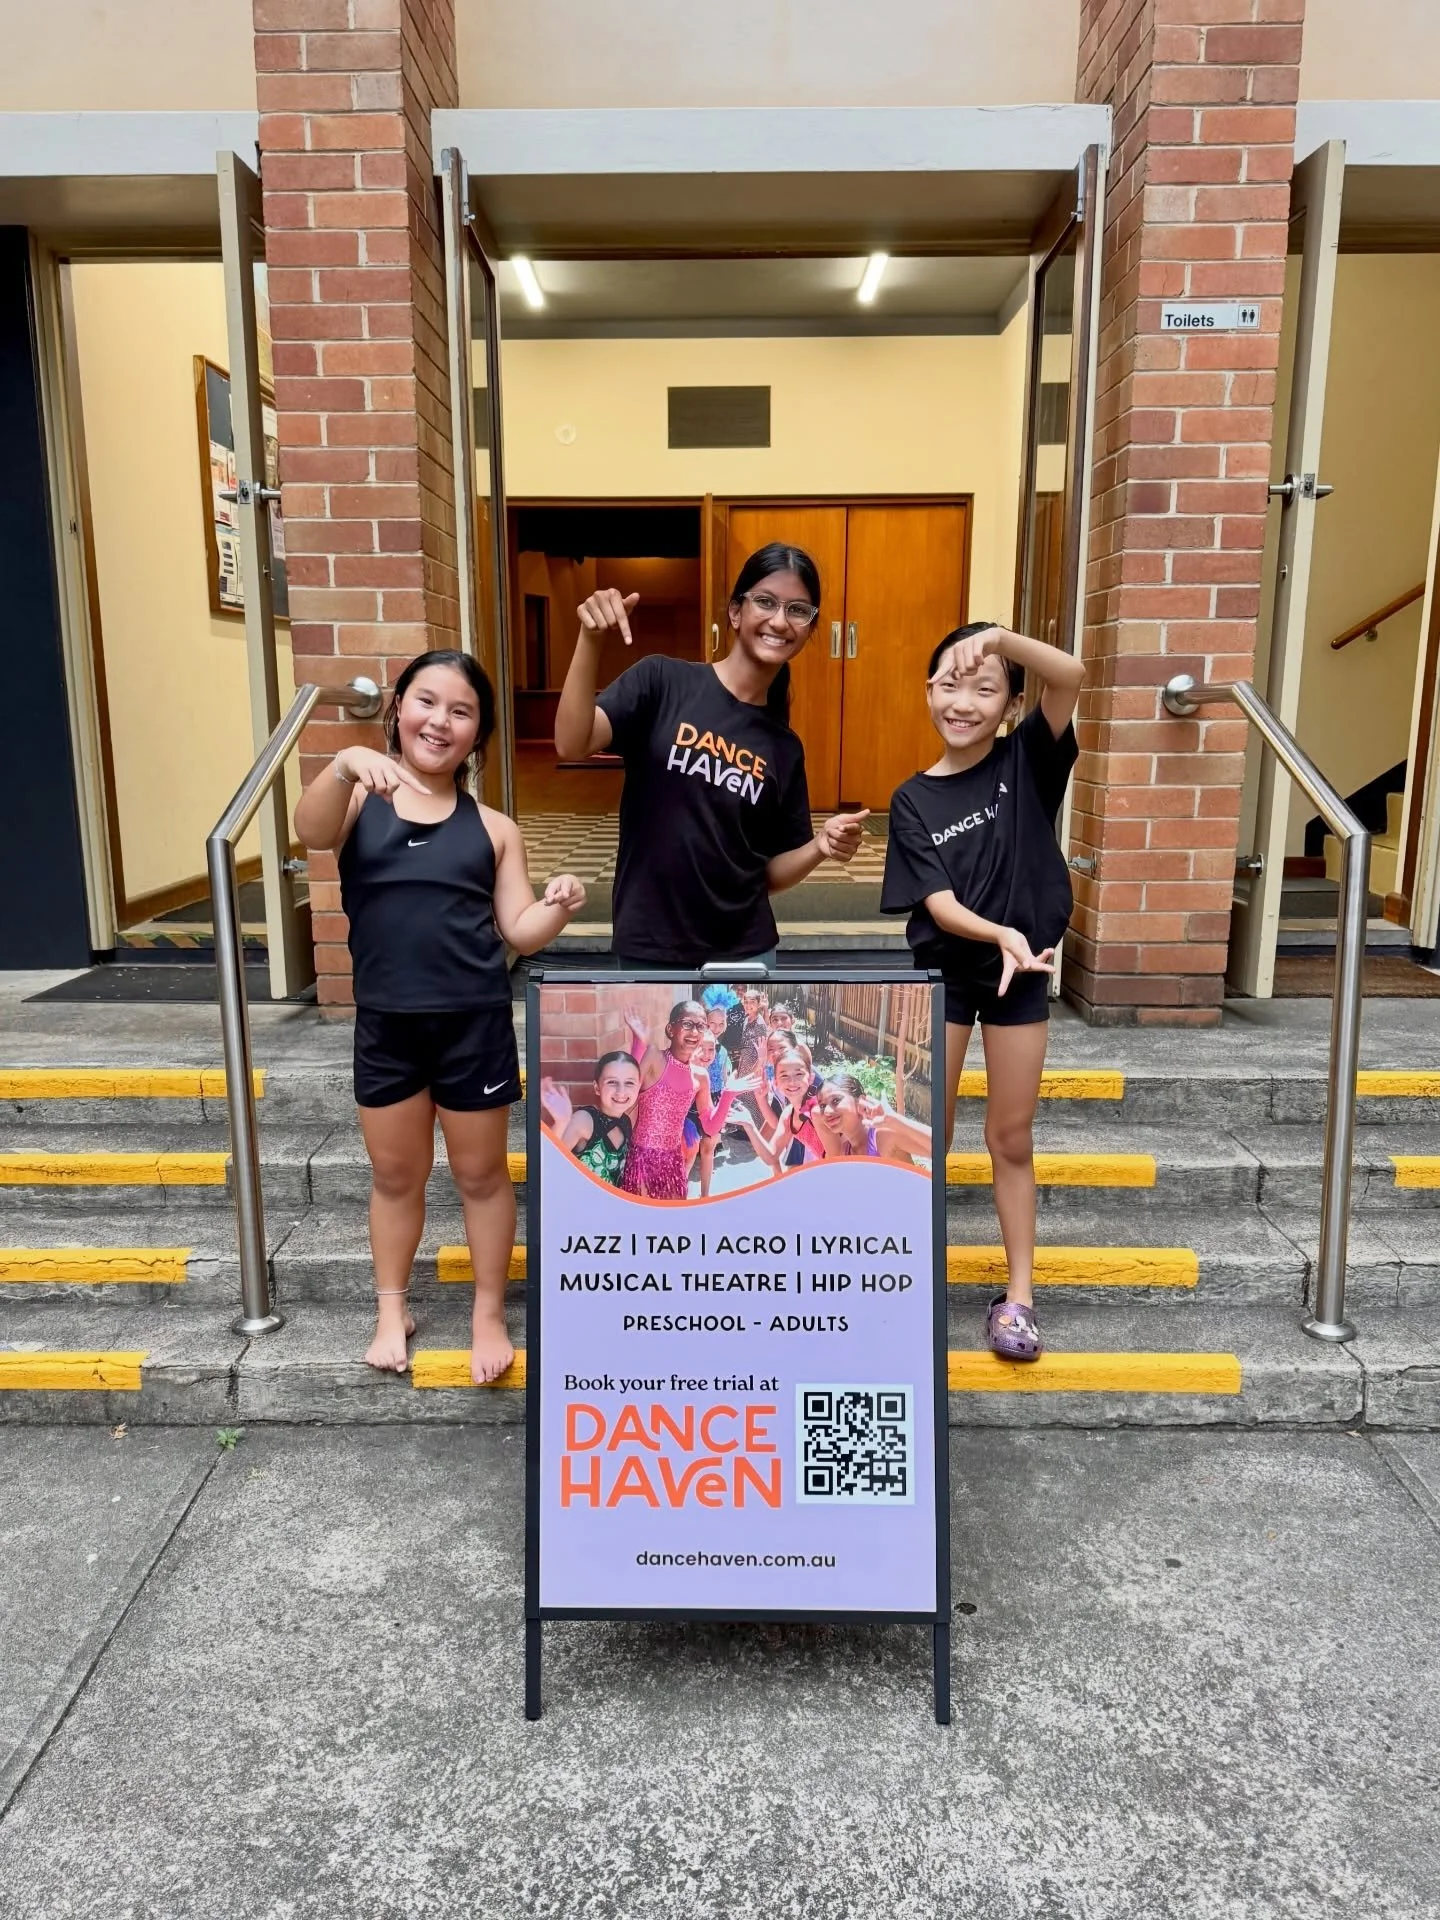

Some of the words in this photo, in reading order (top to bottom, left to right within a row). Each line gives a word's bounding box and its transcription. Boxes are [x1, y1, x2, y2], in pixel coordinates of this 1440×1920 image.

[1164, 313, 1215, 328] Toilets
[675, 722, 767, 781] DANCE
[931, 811, 985, 846] DANCE
[559, 1235, 622, 1254] JAZZ
[645, 1235, 692, 1254] TAP
[715, 1235, 787, 1255] ACRO
[811, 1235, 913, 1255] LYRICAL
[560, 1272, 673, 1292] MUSICAL
[680, 1273, 787, 1292] THEATRE
[812, 1273, 852, 1293] HIP
[861, 1273, 913, 1293] HOP
[623, 1314, 746, 1332] PRESCHOOL
[769, 1315, 849, 1332] ADULTS
[564, 1373, 616, 1391] Book
[619, 1378, 666, 1394] your
[670, 1374, 709, 1391] free
[713, 1374, 754, 1391] trial
[759, 1376, 780, 1392] at
[565, 1403, 777, 1453] DANCE
[636, 1550, 836, 1568] dancehaven.com.au
